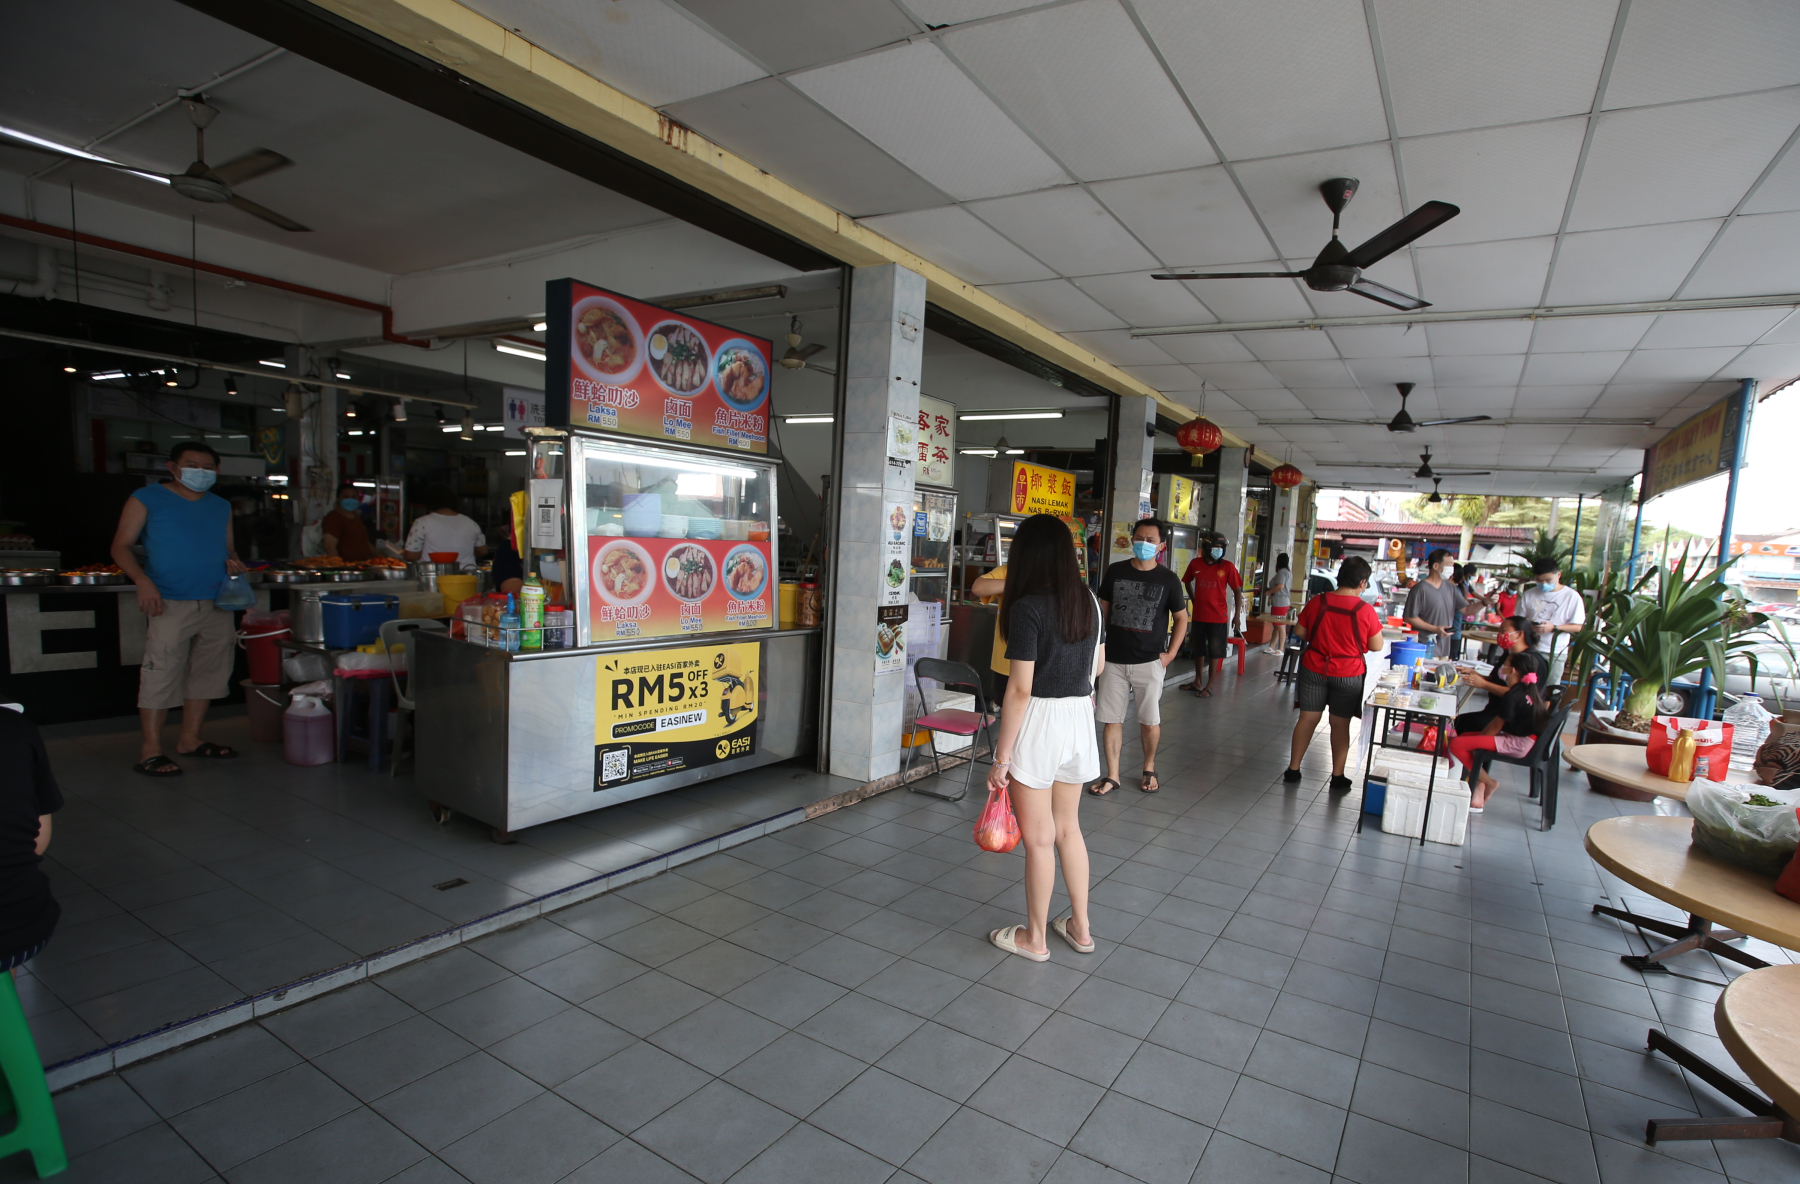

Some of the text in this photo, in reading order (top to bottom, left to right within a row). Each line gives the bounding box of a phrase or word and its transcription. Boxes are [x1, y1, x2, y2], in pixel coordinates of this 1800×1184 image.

[573, 378, 639, 409] 鮮蛤叻沙
[589, 402, 617, 416] Laksa
[587, 414, 600, 424] RM
[663, 415, 692, 430] Lo Mee
[715, 407, 764, 432] 魚片米粉
[664, 426, 675, 436] RM
[712, 425, 765, 442] Fish Fillet Meehoon
[728, 437, 738, 446] RM
[1016, 474, 1027, 507] 早市
[1028, 506, 1042, 514] NAS
[1031, 497, 1069, 508] NASI LEMAK
[601, 603, 651, 621] 鮮蛤叻沙
[726, 599, 765, 614] 魚片米粉
[616, 620, 637, 629] Laksa
[680, 616, 702, 625] Lo Mee
[623, 659, 700, 675] 本店现已入驻EASI百家外卖
[611, 669, 708, 711] RM5 OFF
[688, 681, 709, 700] x3
[638, 705, 679, 717] SPENDING
[615, 712, 703, 735] PROMOCODE EASINEW
[731, 736, 751, 748] EASI
